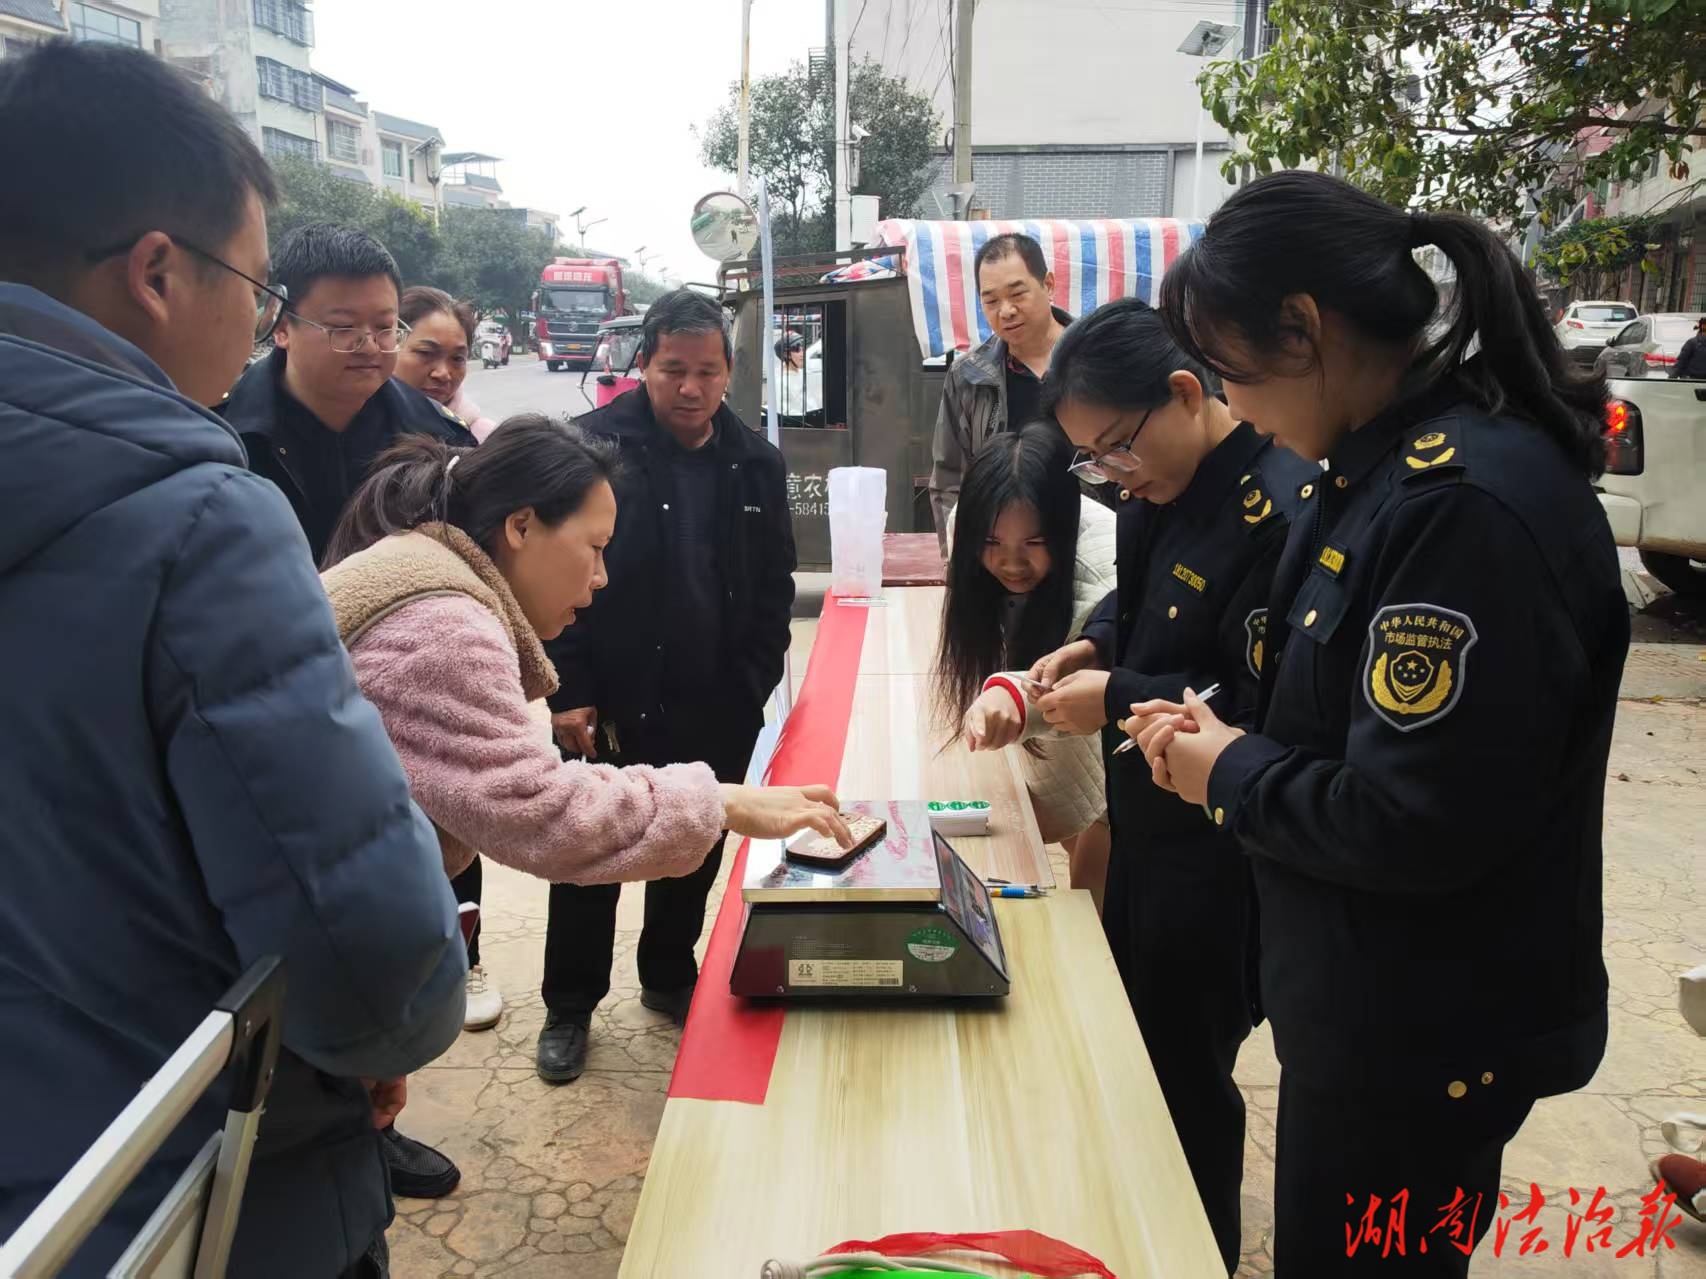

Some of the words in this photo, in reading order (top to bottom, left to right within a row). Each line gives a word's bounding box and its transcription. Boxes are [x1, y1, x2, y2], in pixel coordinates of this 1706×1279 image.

[786, 472, 829, 500] 意农
[1379, 615, 1465, 639] 中华人民共和国
[1384, 631, 1455, 650] 市场监管执法
